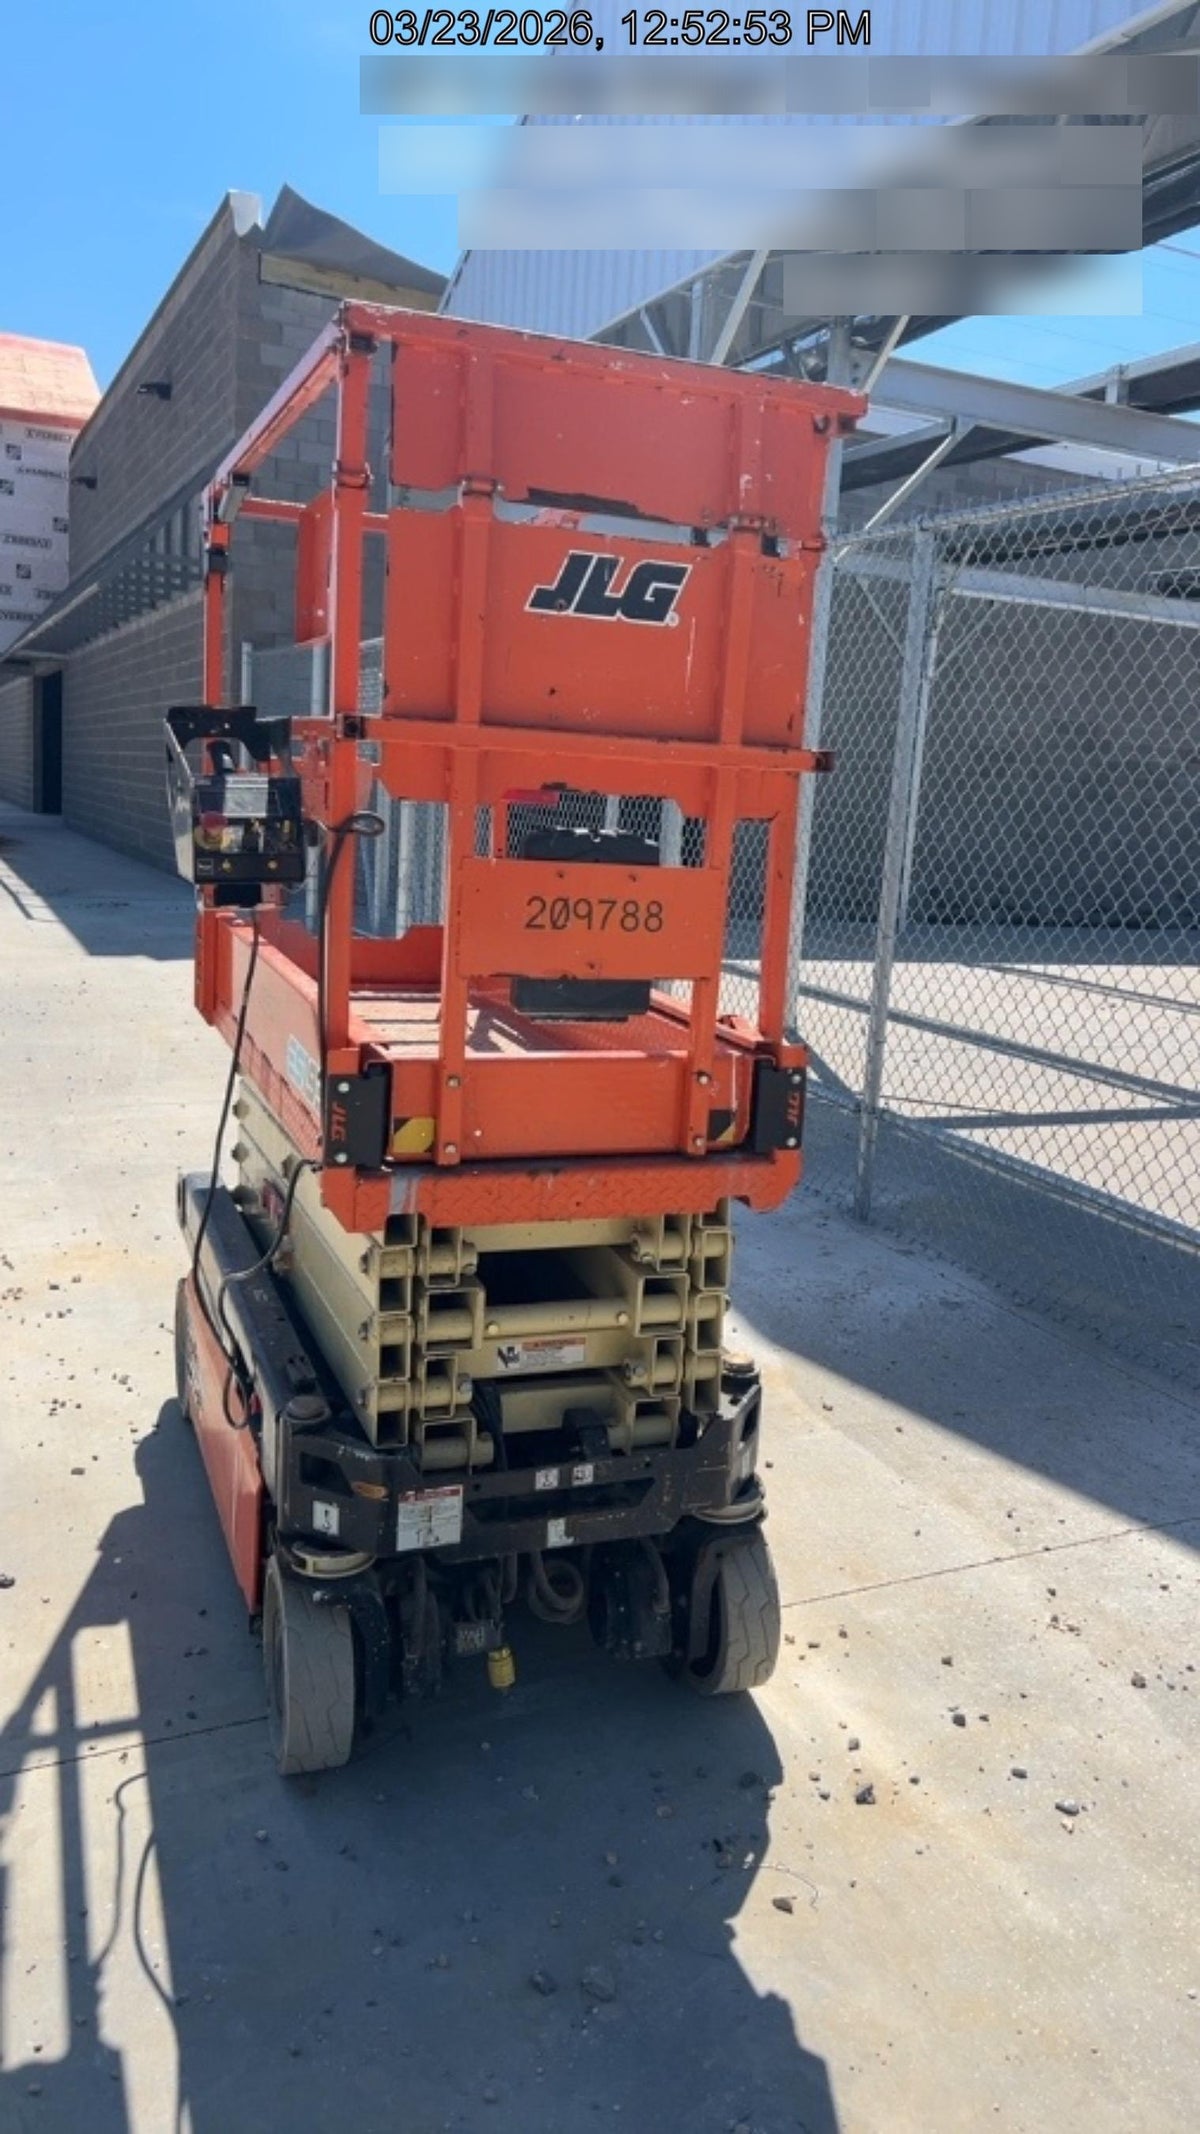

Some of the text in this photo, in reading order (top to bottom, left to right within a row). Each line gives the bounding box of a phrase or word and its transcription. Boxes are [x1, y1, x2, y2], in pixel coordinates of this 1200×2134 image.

[524, 550, 693, 626] JLG
[525, 896, 663, 932] 209788
[331, 1101, 348, 1141] JLG
